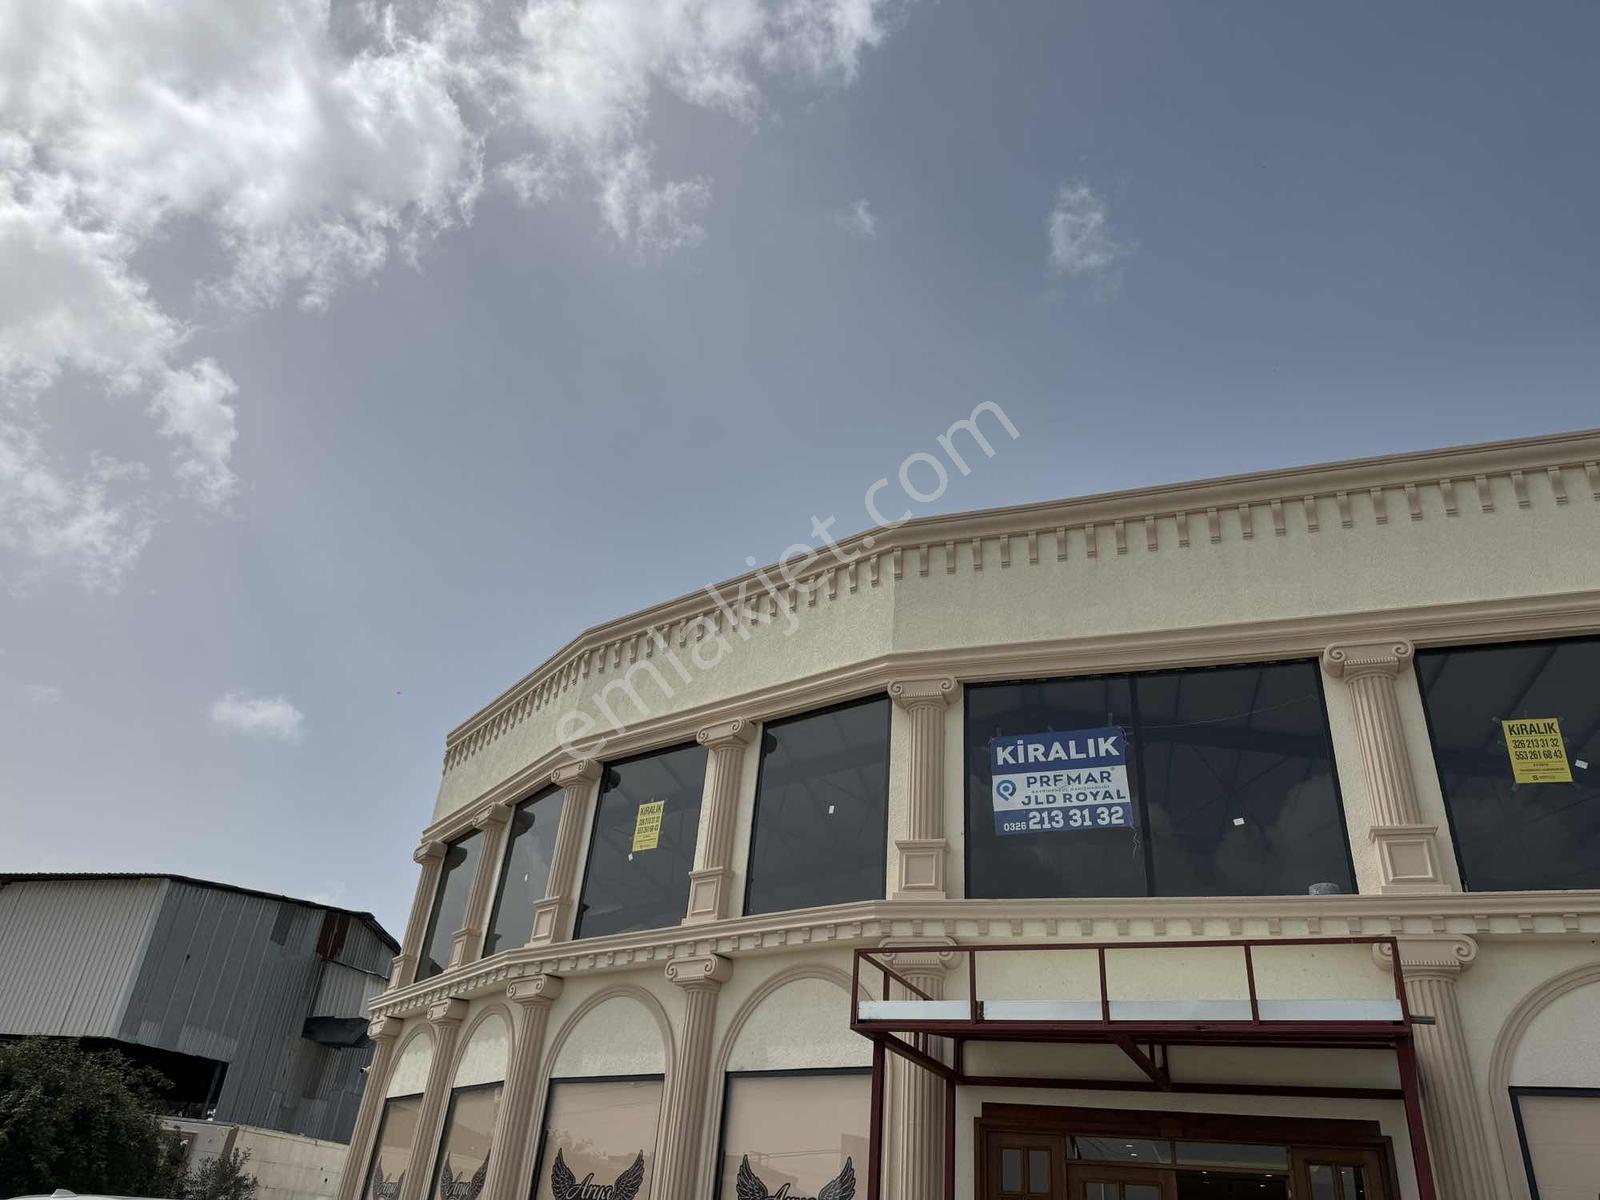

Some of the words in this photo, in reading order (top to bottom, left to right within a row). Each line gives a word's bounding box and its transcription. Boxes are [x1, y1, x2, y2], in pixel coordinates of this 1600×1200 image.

[1021, 794, 1057, 806] JLD
[1063, 789, 1126, 803] ROYAL
[1003, 822, 1027, 832] 0326
[1028, 810, 1064, 830] 213
[1069, 808, 1093, 827] 31
[1097, 806, 1125, 825] 32
